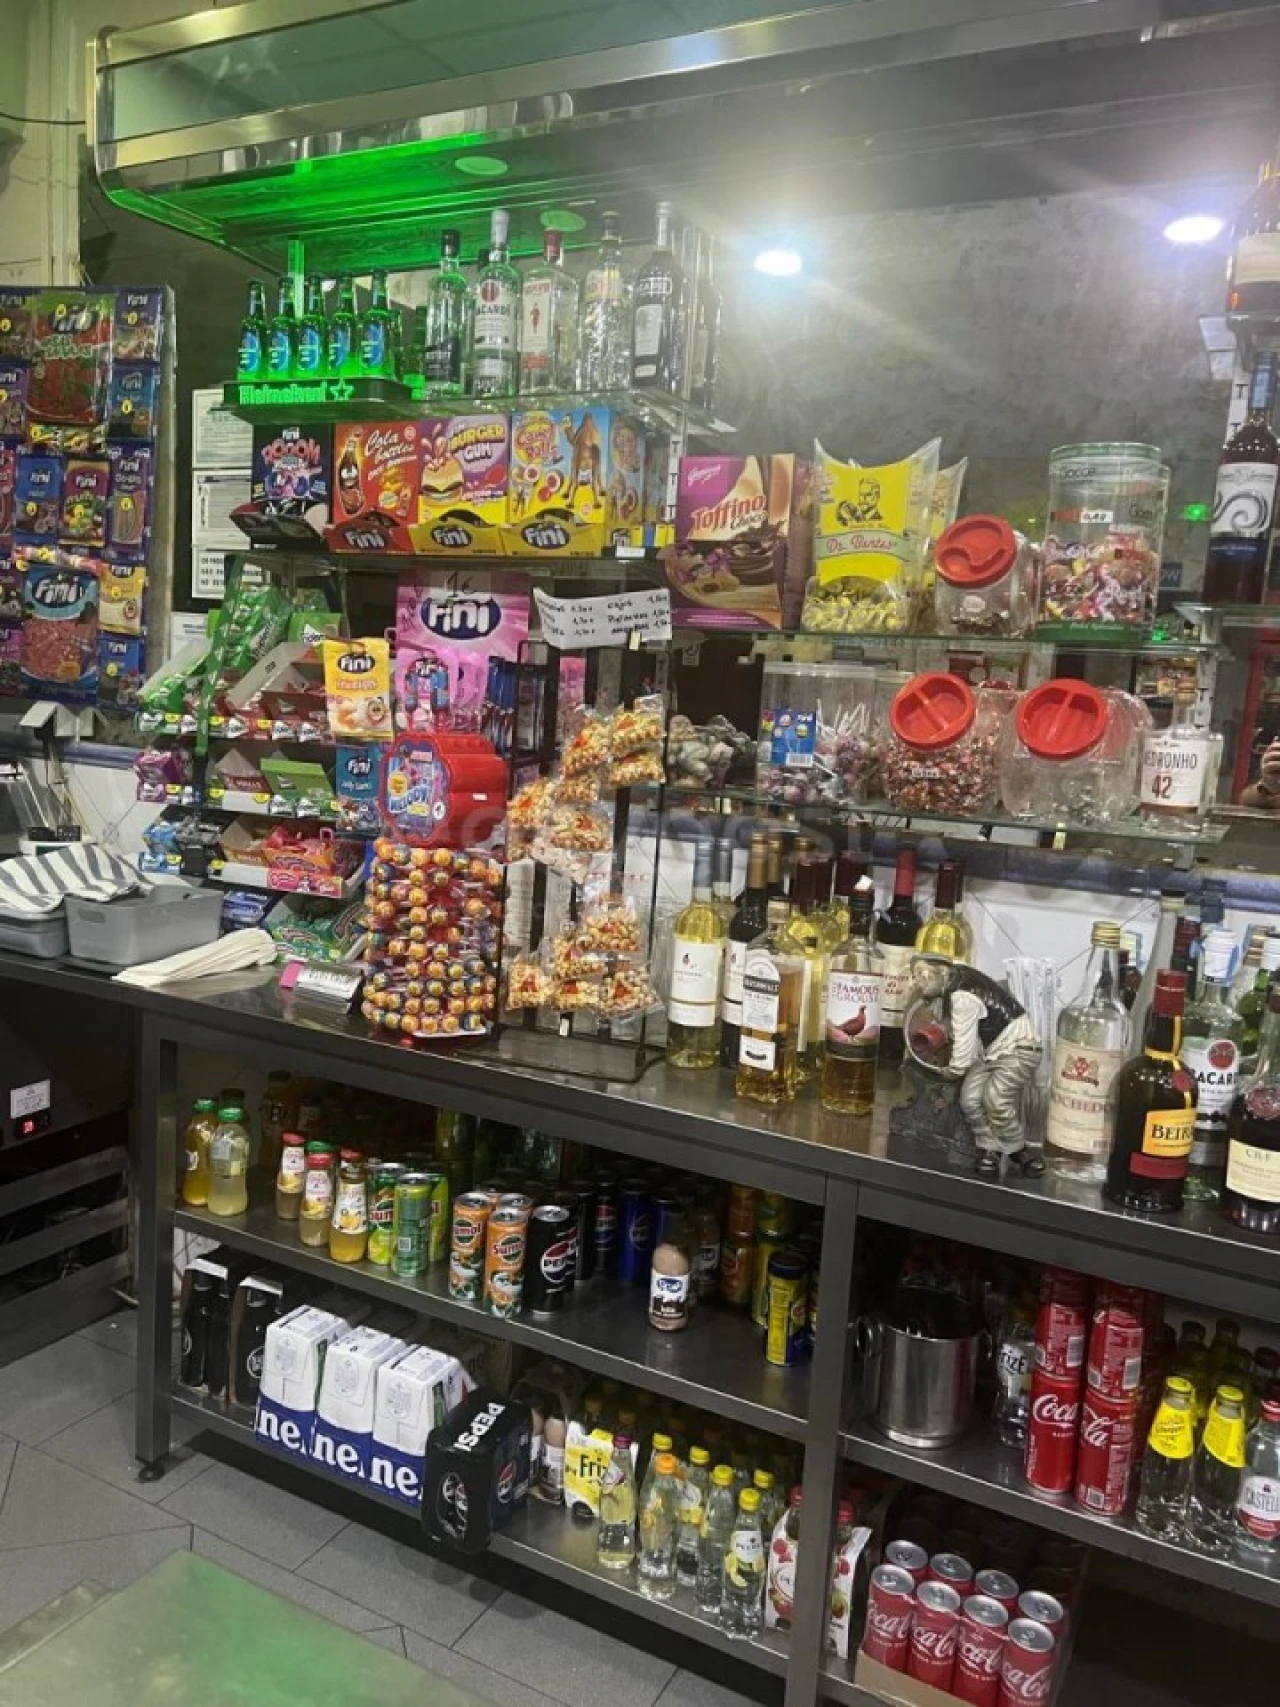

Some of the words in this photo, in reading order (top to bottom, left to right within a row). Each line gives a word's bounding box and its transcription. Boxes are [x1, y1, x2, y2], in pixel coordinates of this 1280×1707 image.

[365, 429, 399, 457] Cola
[449, 424, 505, 452] BURGER
[464, 442, 492, 462] GUM
[344, 530, 386, 548] Fini
[431, 526, 470, 547] Fini
[523, 526, 569, 548] Fini
[339, 654, 372, 672] Fini
[347, 757, 372, 775] Fini
[1151, 774, 1173, 799] 42
[1193, 1070, 1236, 1086] ACAR
[453, 1402, 506, 1453] PEPSI
